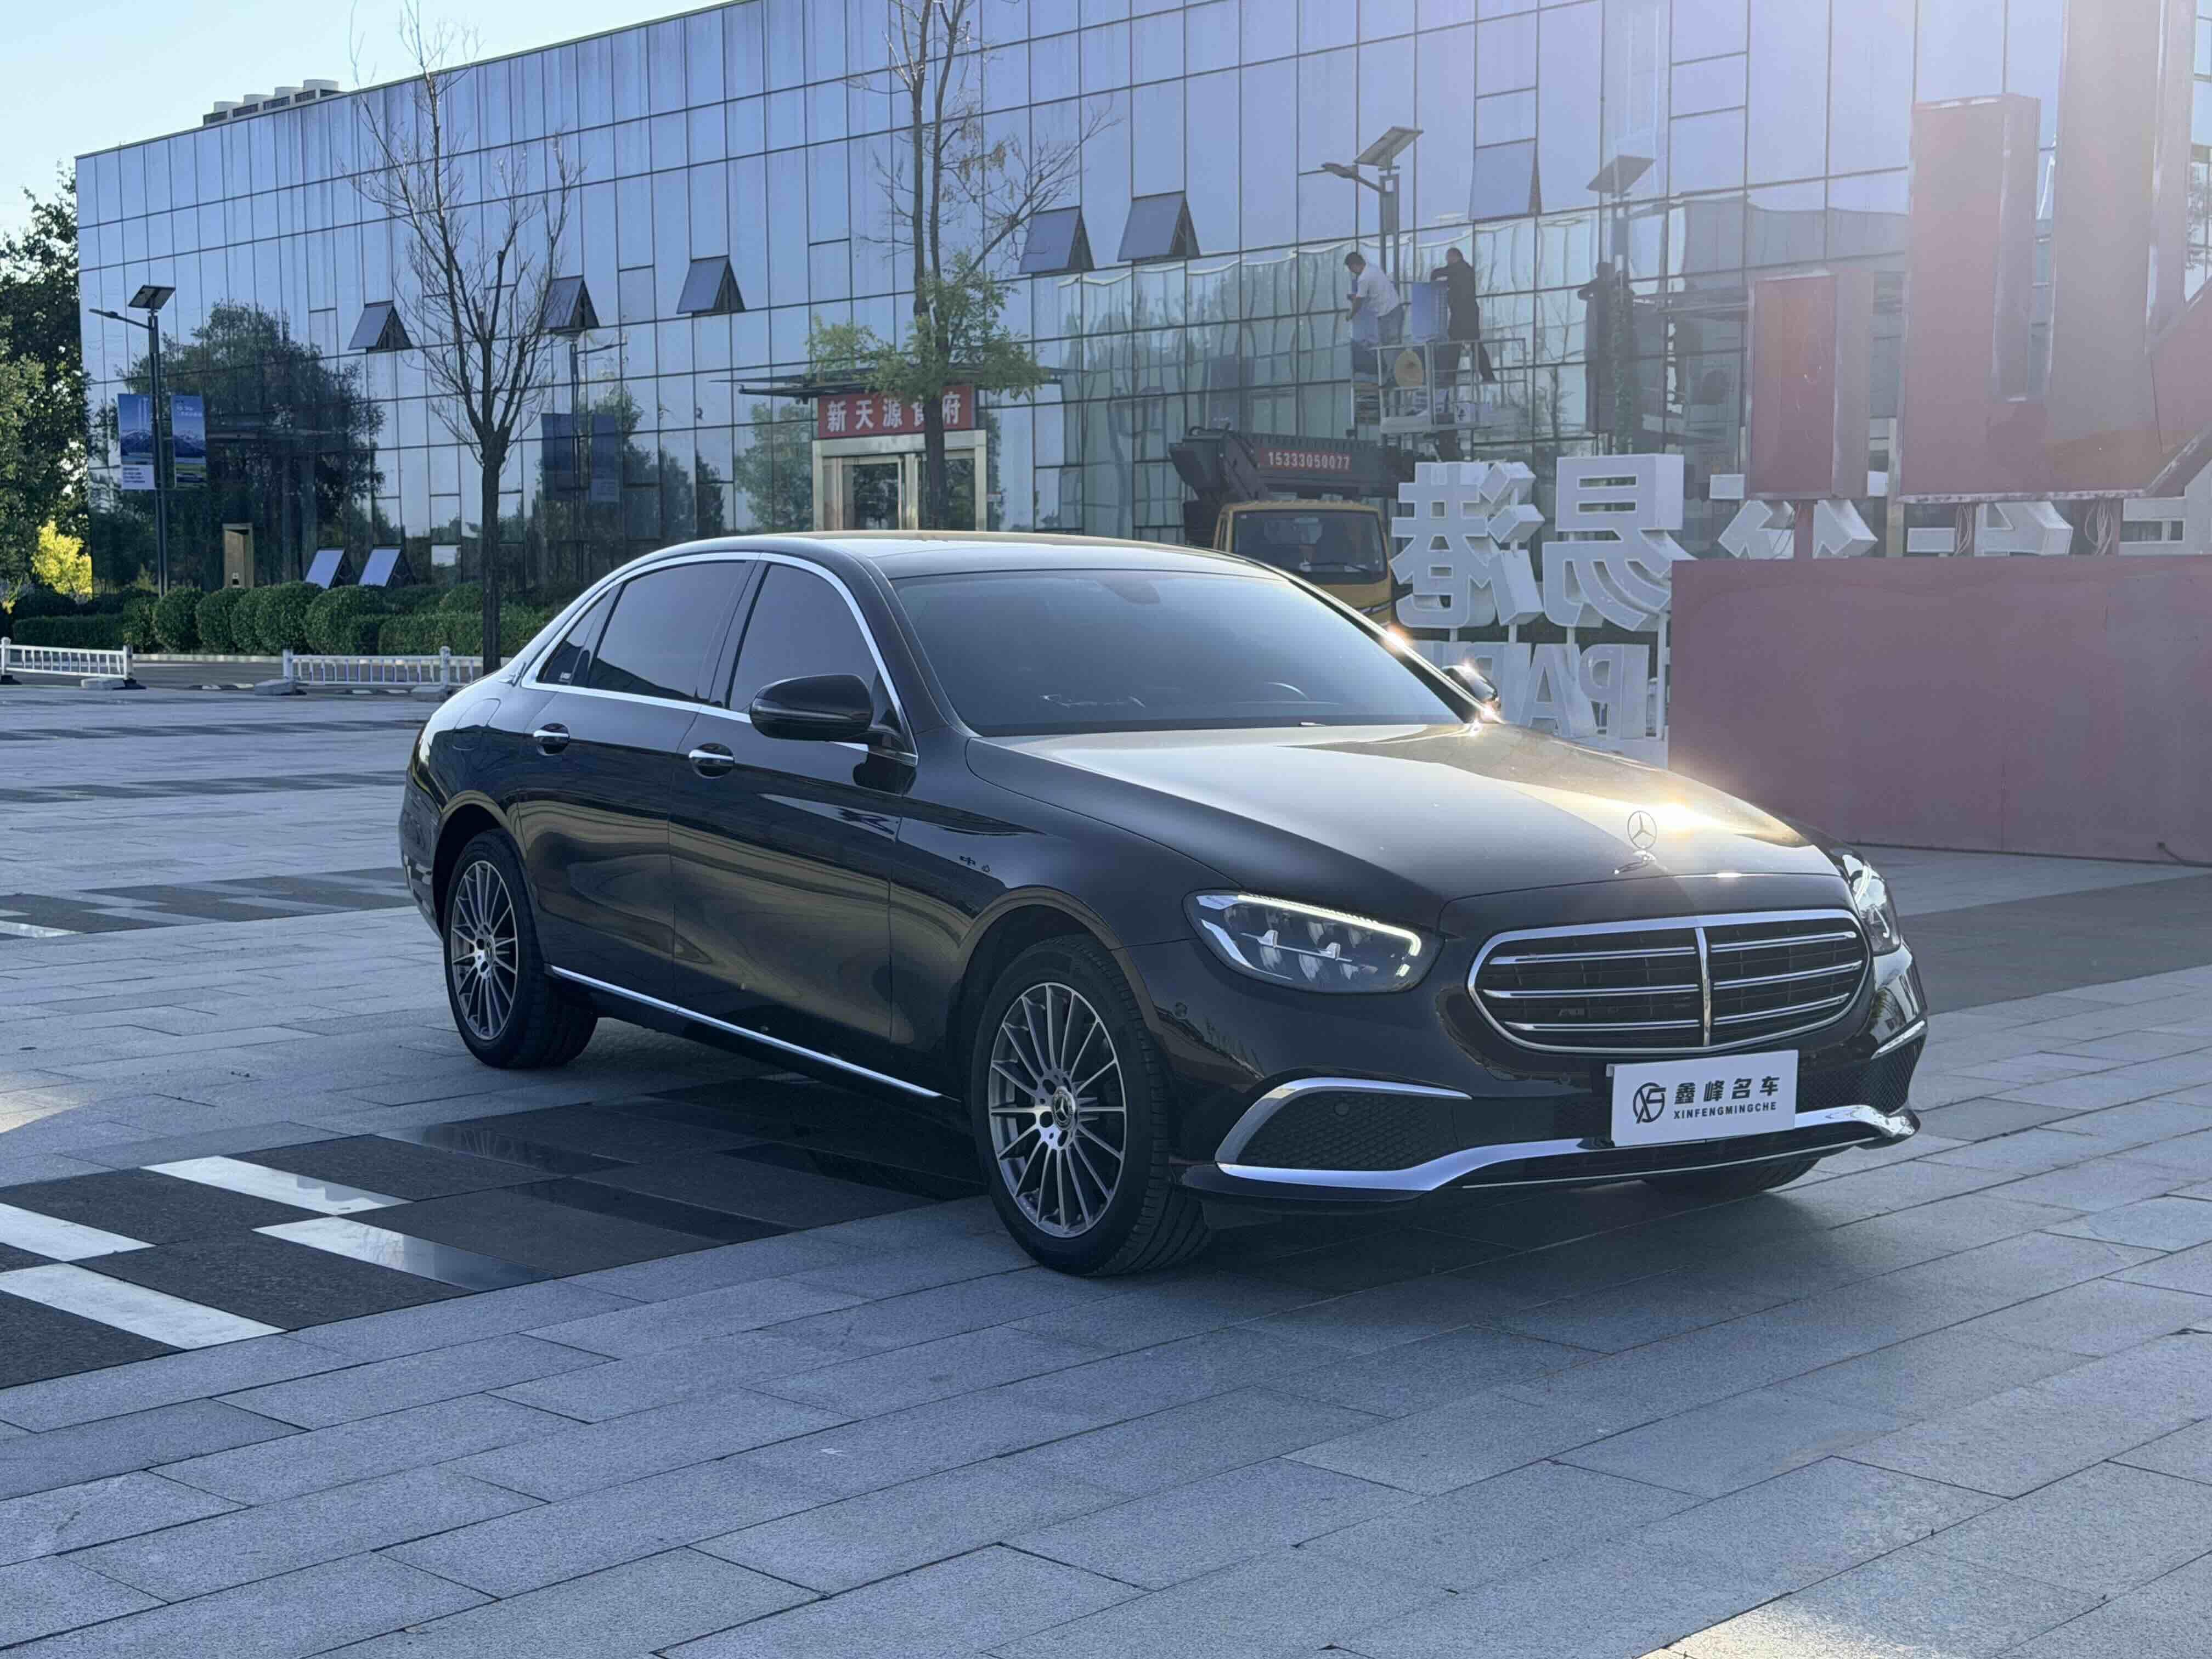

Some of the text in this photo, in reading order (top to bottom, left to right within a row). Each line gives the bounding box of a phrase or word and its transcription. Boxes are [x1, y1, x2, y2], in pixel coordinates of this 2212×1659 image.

[1268, 451, 1350, 470] 15333050077
[1674, 1075, 1780, 1105] 鑫峰名车
[1673, 1101, 1777, 1120] XINFENGMINGCHE
